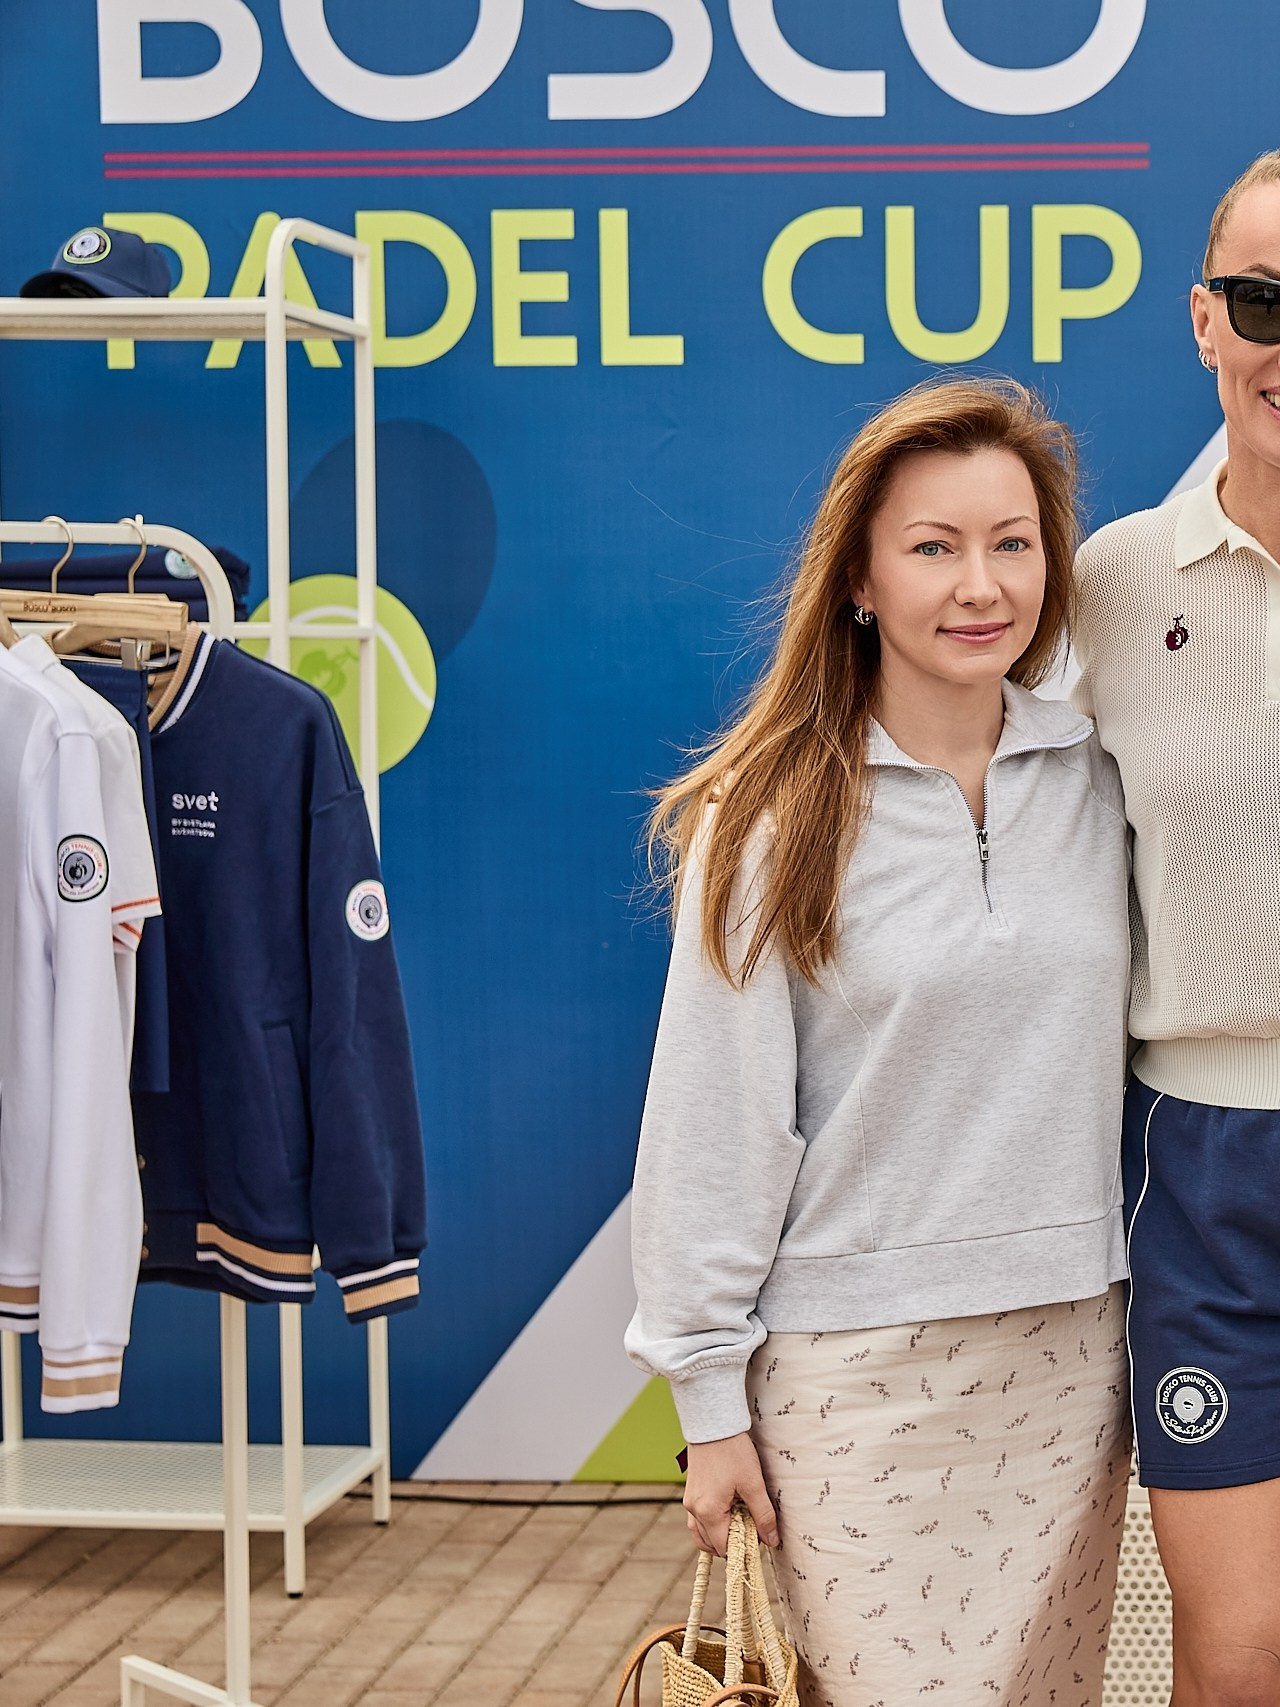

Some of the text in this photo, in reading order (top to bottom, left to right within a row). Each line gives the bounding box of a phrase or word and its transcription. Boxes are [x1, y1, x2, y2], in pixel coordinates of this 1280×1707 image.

[762, 204, 1143, 364] CUP
[172, 791, 219, 812] svet
[1162, 1374, 1218, 1403] BOSCO TENNIS CLUB
